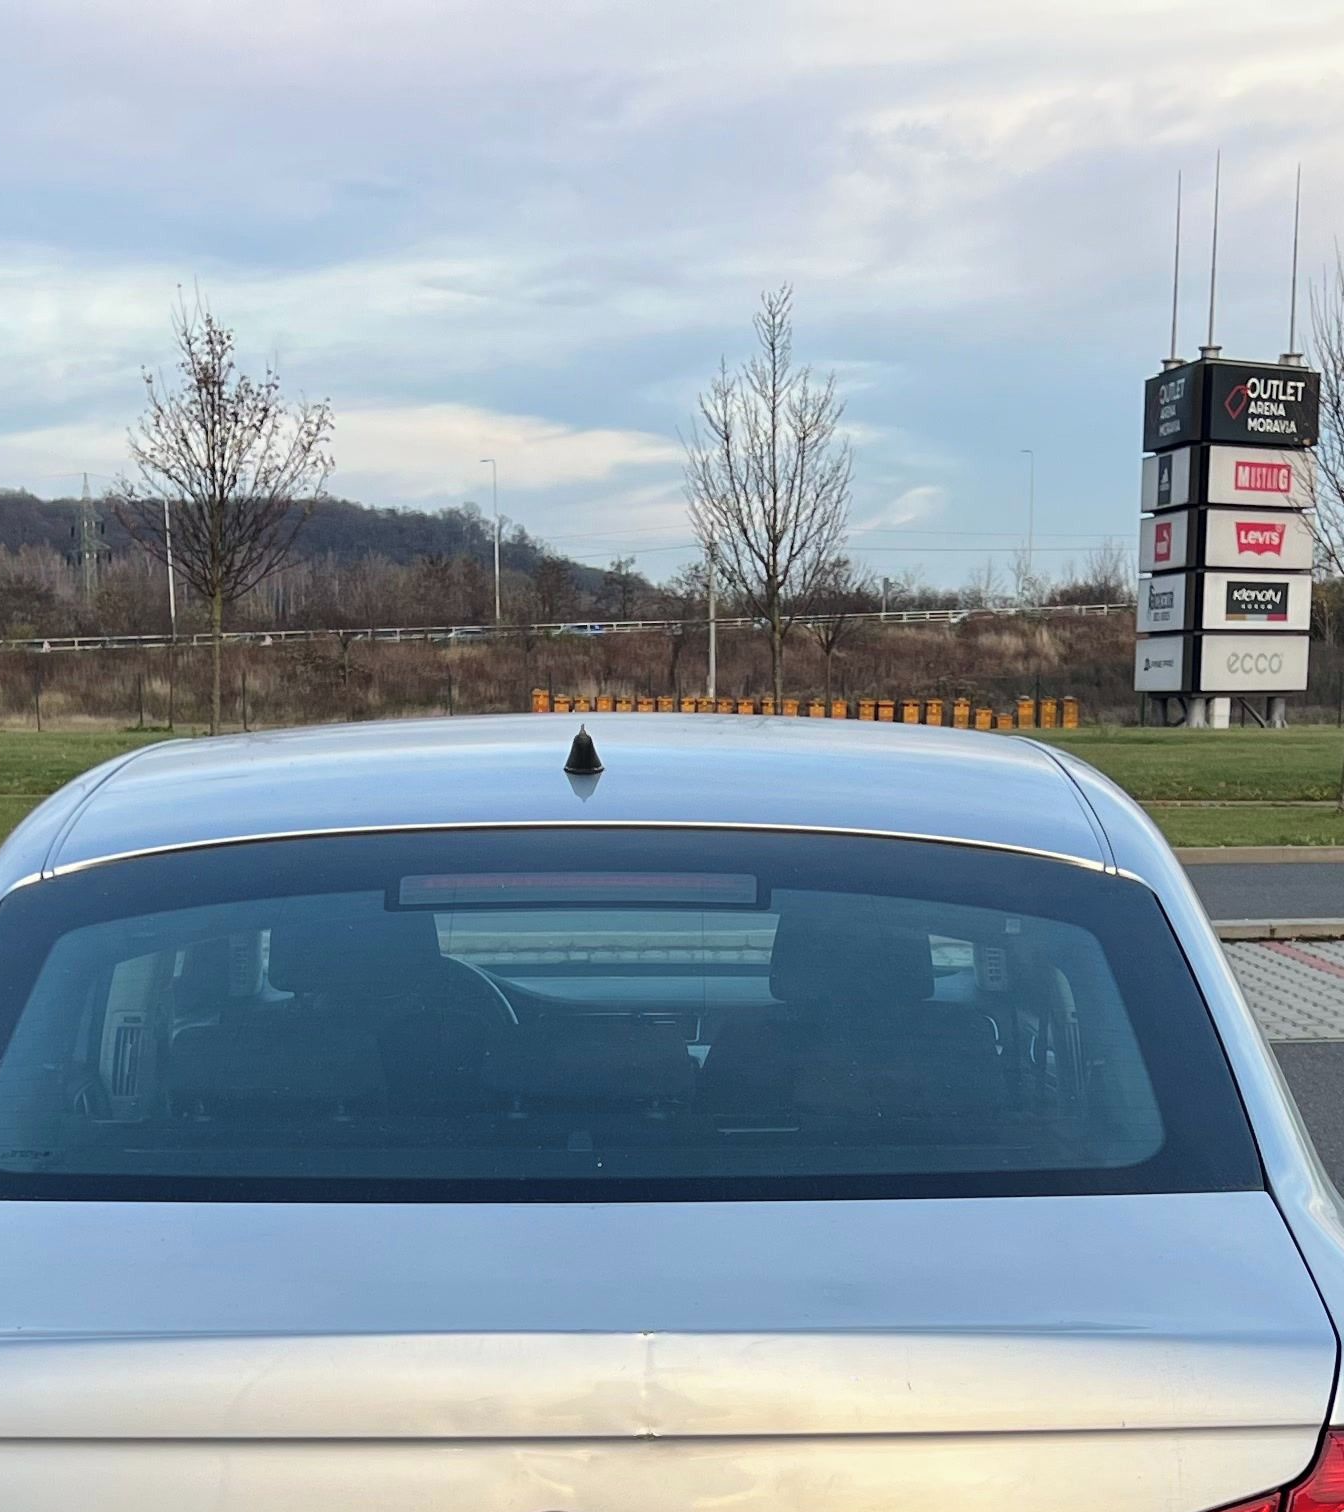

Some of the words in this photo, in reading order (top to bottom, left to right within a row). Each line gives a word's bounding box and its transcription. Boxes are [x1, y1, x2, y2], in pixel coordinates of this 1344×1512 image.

[1246, 377, 1305, 402] OUTLET
[1247, 400, 1286, 416] ARENA
[1247, 417, 1297, 434] MORAVIA
[1226, 652, 1283, 675] ecco
